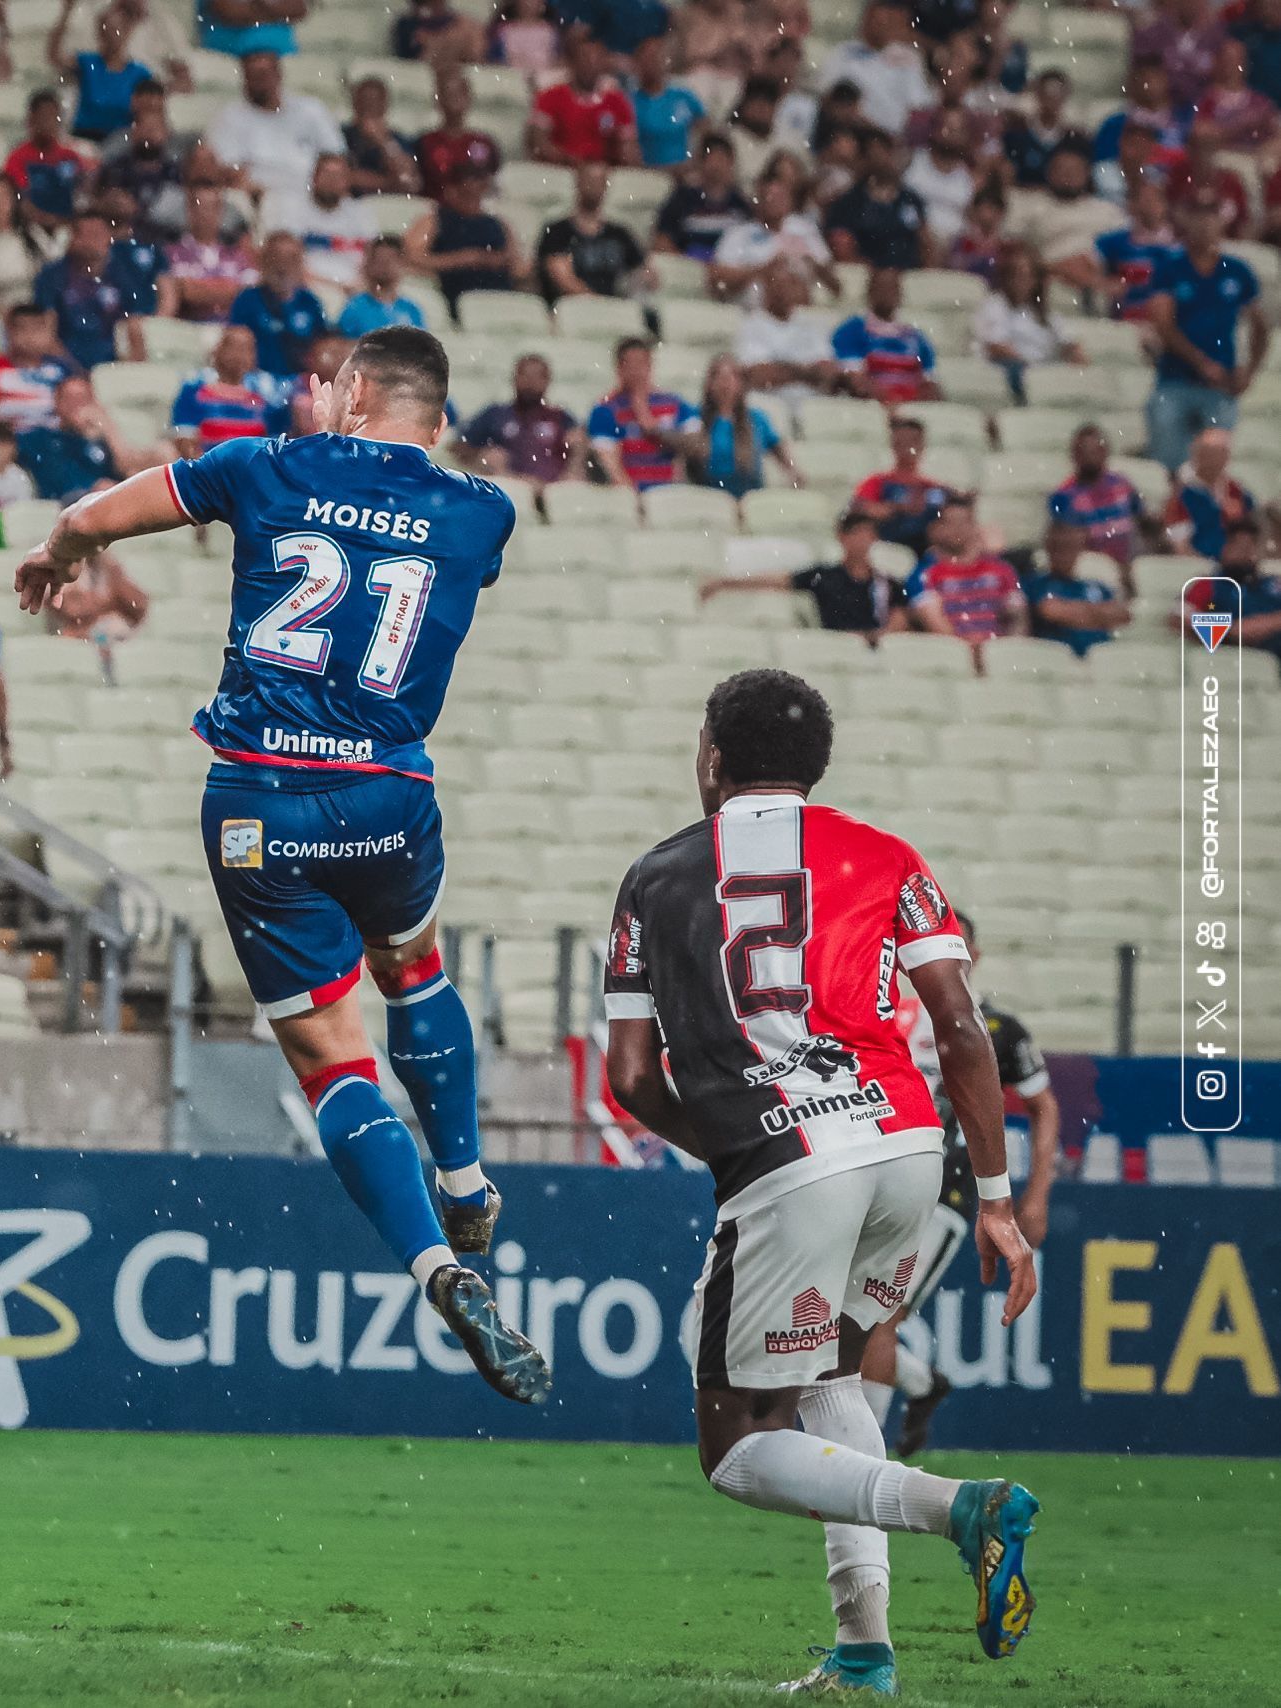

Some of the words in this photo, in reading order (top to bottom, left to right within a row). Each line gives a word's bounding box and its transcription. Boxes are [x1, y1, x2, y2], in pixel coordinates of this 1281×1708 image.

[303, 497, 431, 543] MOISÉS
[297, 543, 319, 551] VOLT
[401, 564, 422, 577] VOLT
[299, 575, 331, 602] FTRADE
[243, 531, 436, 699] 21
[393, 592, 411, 632] FTRADE
[262, 727, 373, 757] Unimed
[267, 831, 406, 859] COMBUSTÍVEIS
[627, 917, 642, 955] CARNE
[716, 868, 813, 1022] 2
[625, 957, 639, 974] DA
[758, 1061, 786, 1080] SÃO
[762, 1082, 887, 1134] Unimed
[849, 1106, 893, 1123] Fortaleza
